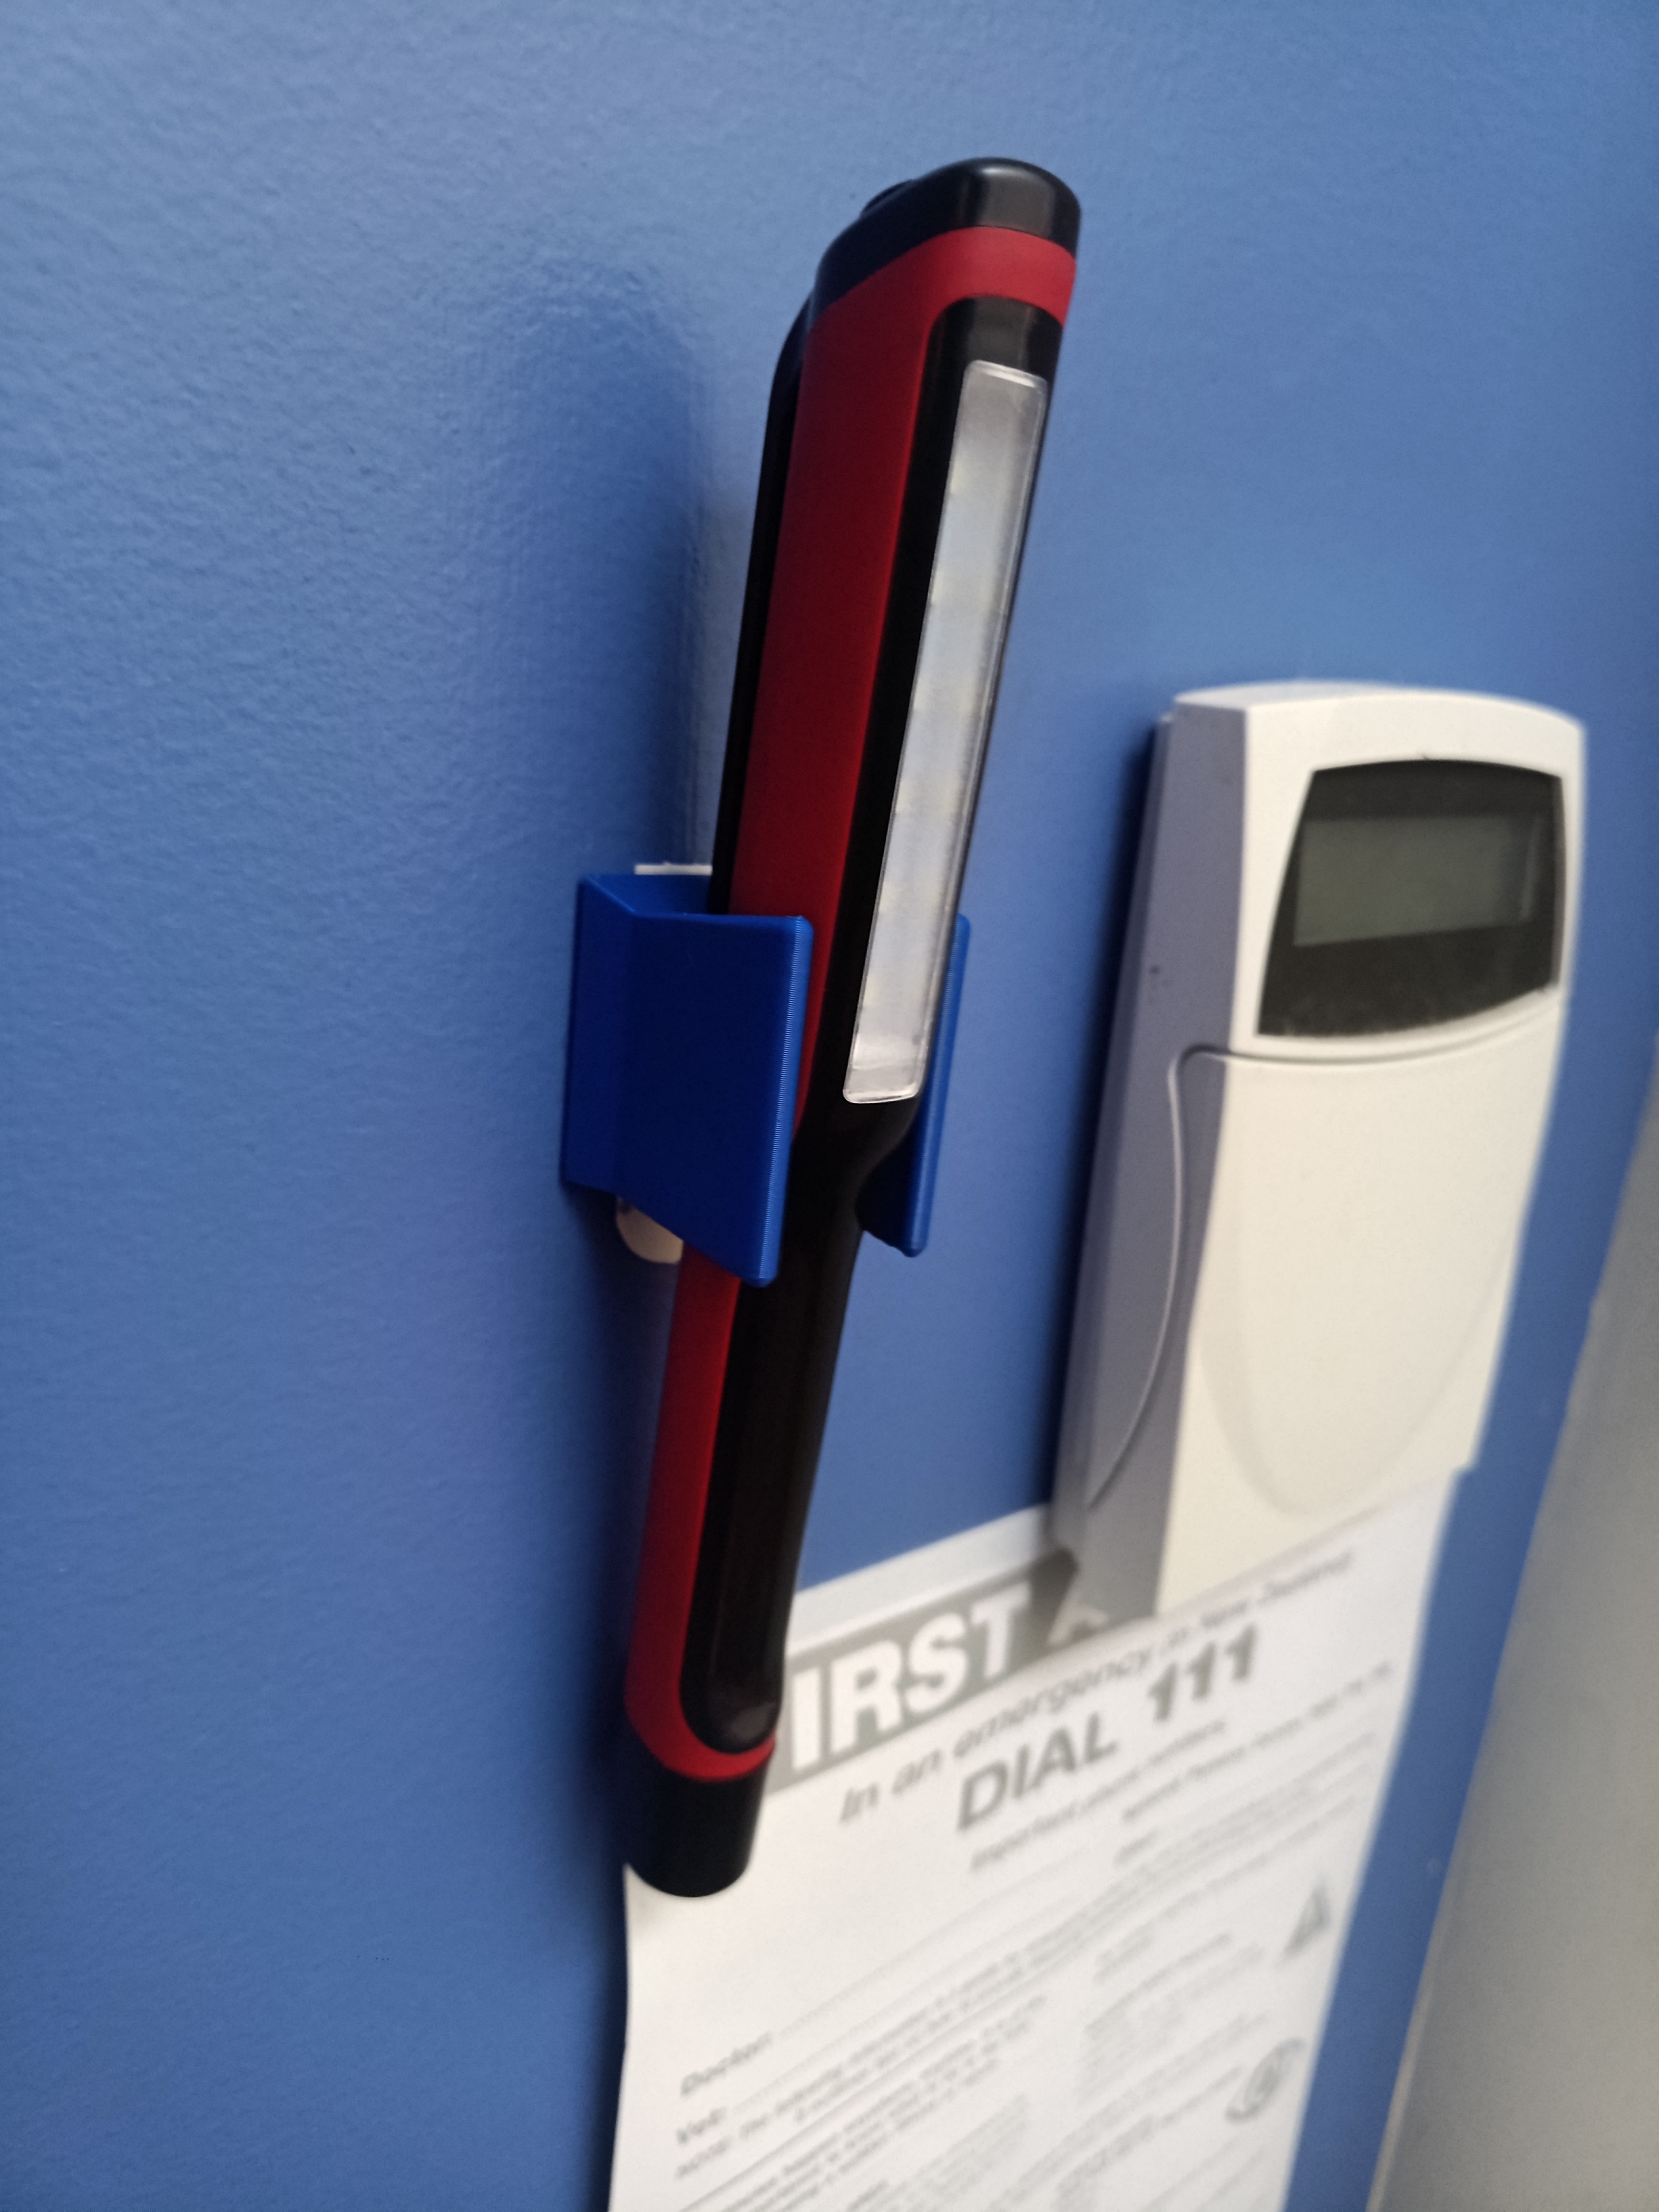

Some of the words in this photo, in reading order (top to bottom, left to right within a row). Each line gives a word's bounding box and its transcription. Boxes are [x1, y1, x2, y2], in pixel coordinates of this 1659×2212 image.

[790, 1583, 1031, 1771] IRST
[958, 1711, 1119, 1833] DIAL
[1147, 1622, 1257, 1723] 111
